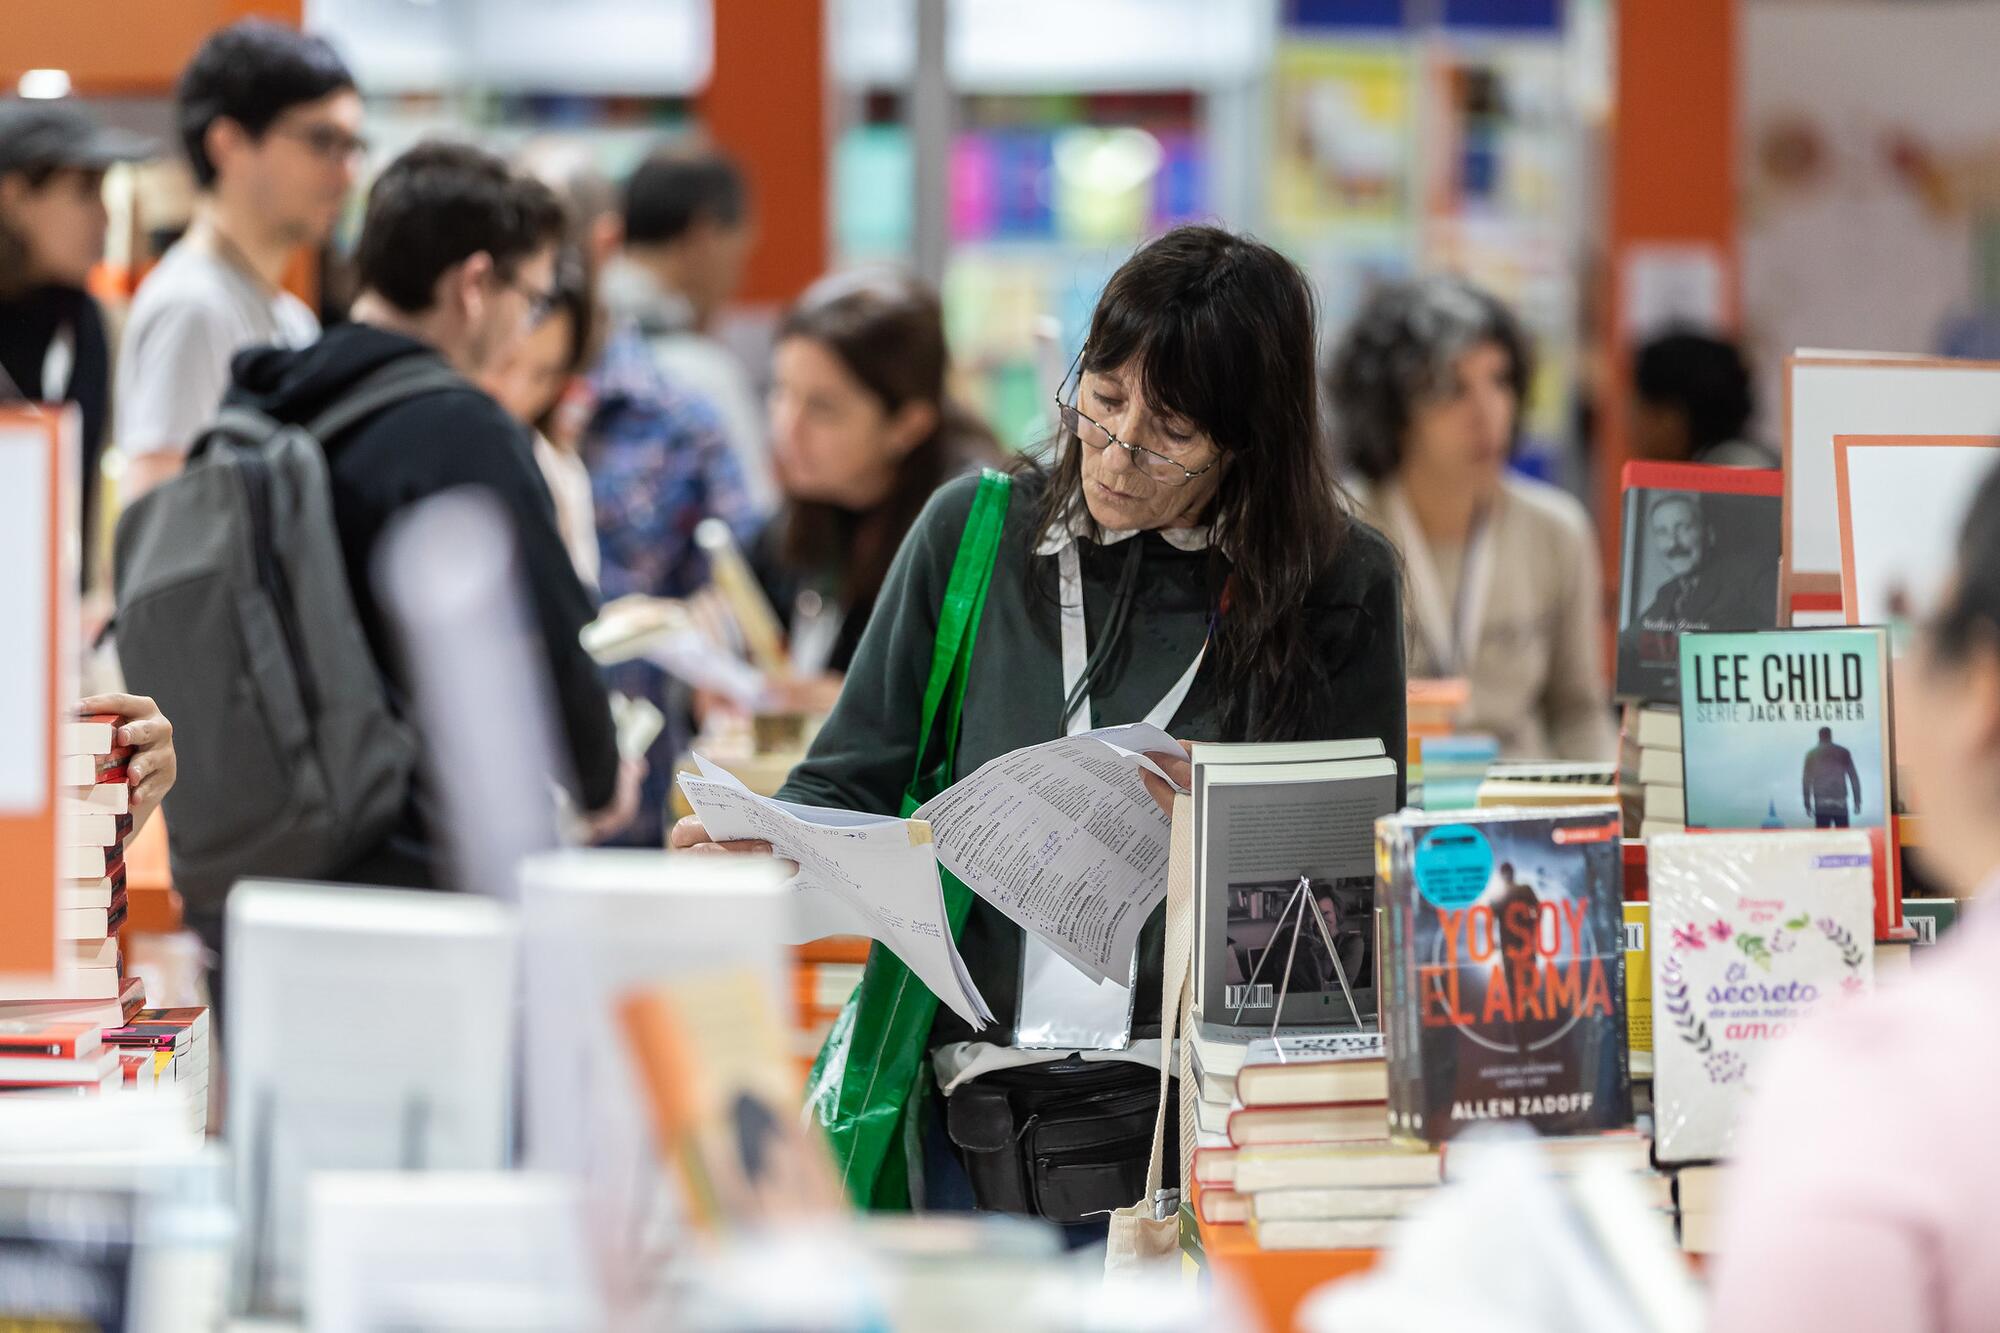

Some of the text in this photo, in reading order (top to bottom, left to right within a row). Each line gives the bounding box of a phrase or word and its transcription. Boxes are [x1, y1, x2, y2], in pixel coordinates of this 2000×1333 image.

[1695, 653, 1863, 704] LEE CHILD
[1697, 703, 1865, 723] SERIE JACK REACHER
[1437, 897, 1589, 964] YO SOY
[1420, 966, 1475, 1028] EL
[1483, 955, 1614, 1025] ARMA
[1707, 981, 1817, 1003] secreto
[1451, 1092, 1593, 1120] ALLEN ZADOFF
